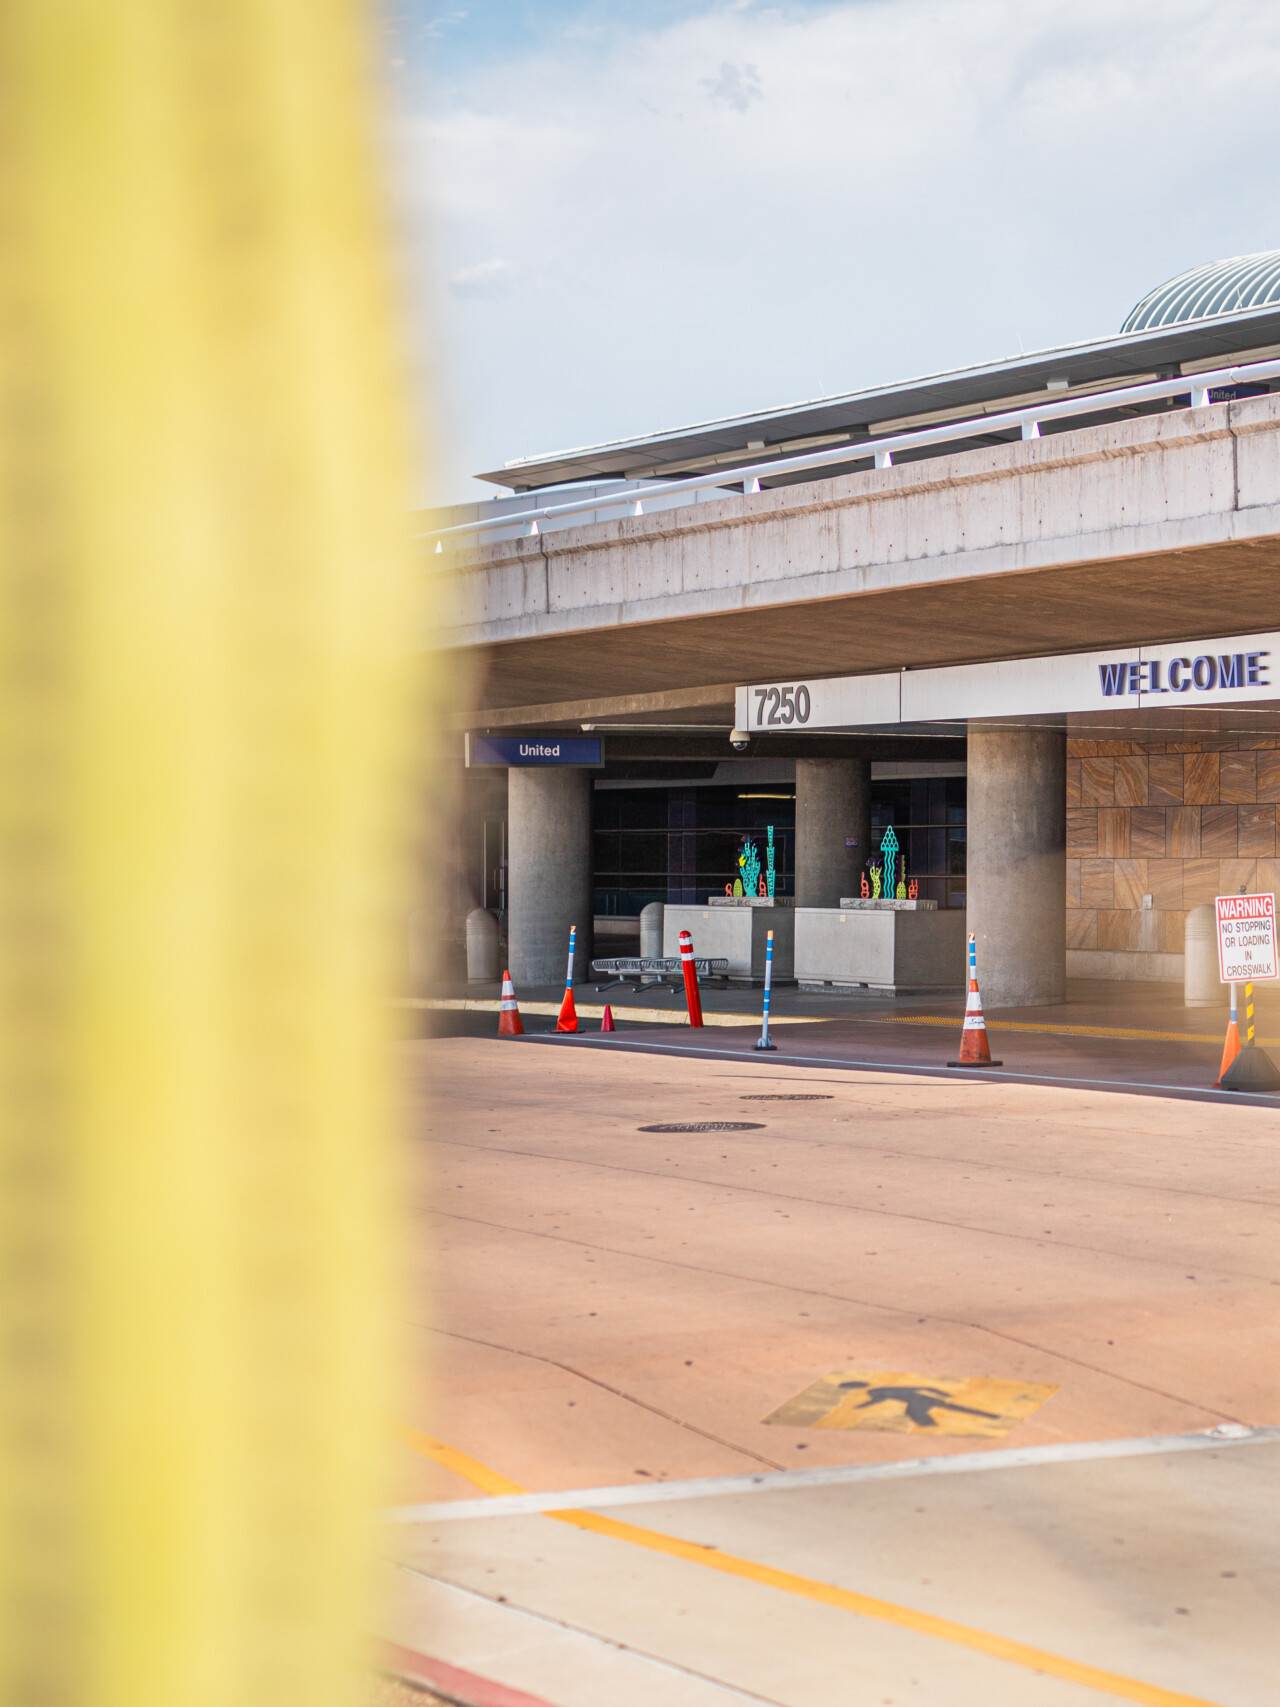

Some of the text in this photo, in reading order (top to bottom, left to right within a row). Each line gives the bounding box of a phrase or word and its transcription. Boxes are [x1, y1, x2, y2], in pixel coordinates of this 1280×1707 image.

[1098, 651, 1270, 697] WELCOME
[754, 684, 811, 726] 7250
[519, 744, 560, 757] United
[1218, 897, 1273, 919] WARNING
[1222, 920, 1271, 933] NO STOPPING
[1225, 934, 1270, 947] OR LOADING
[1244, 950, 1252, 961] IN
[1227, 963, 1271, 976] CROSSWALK
